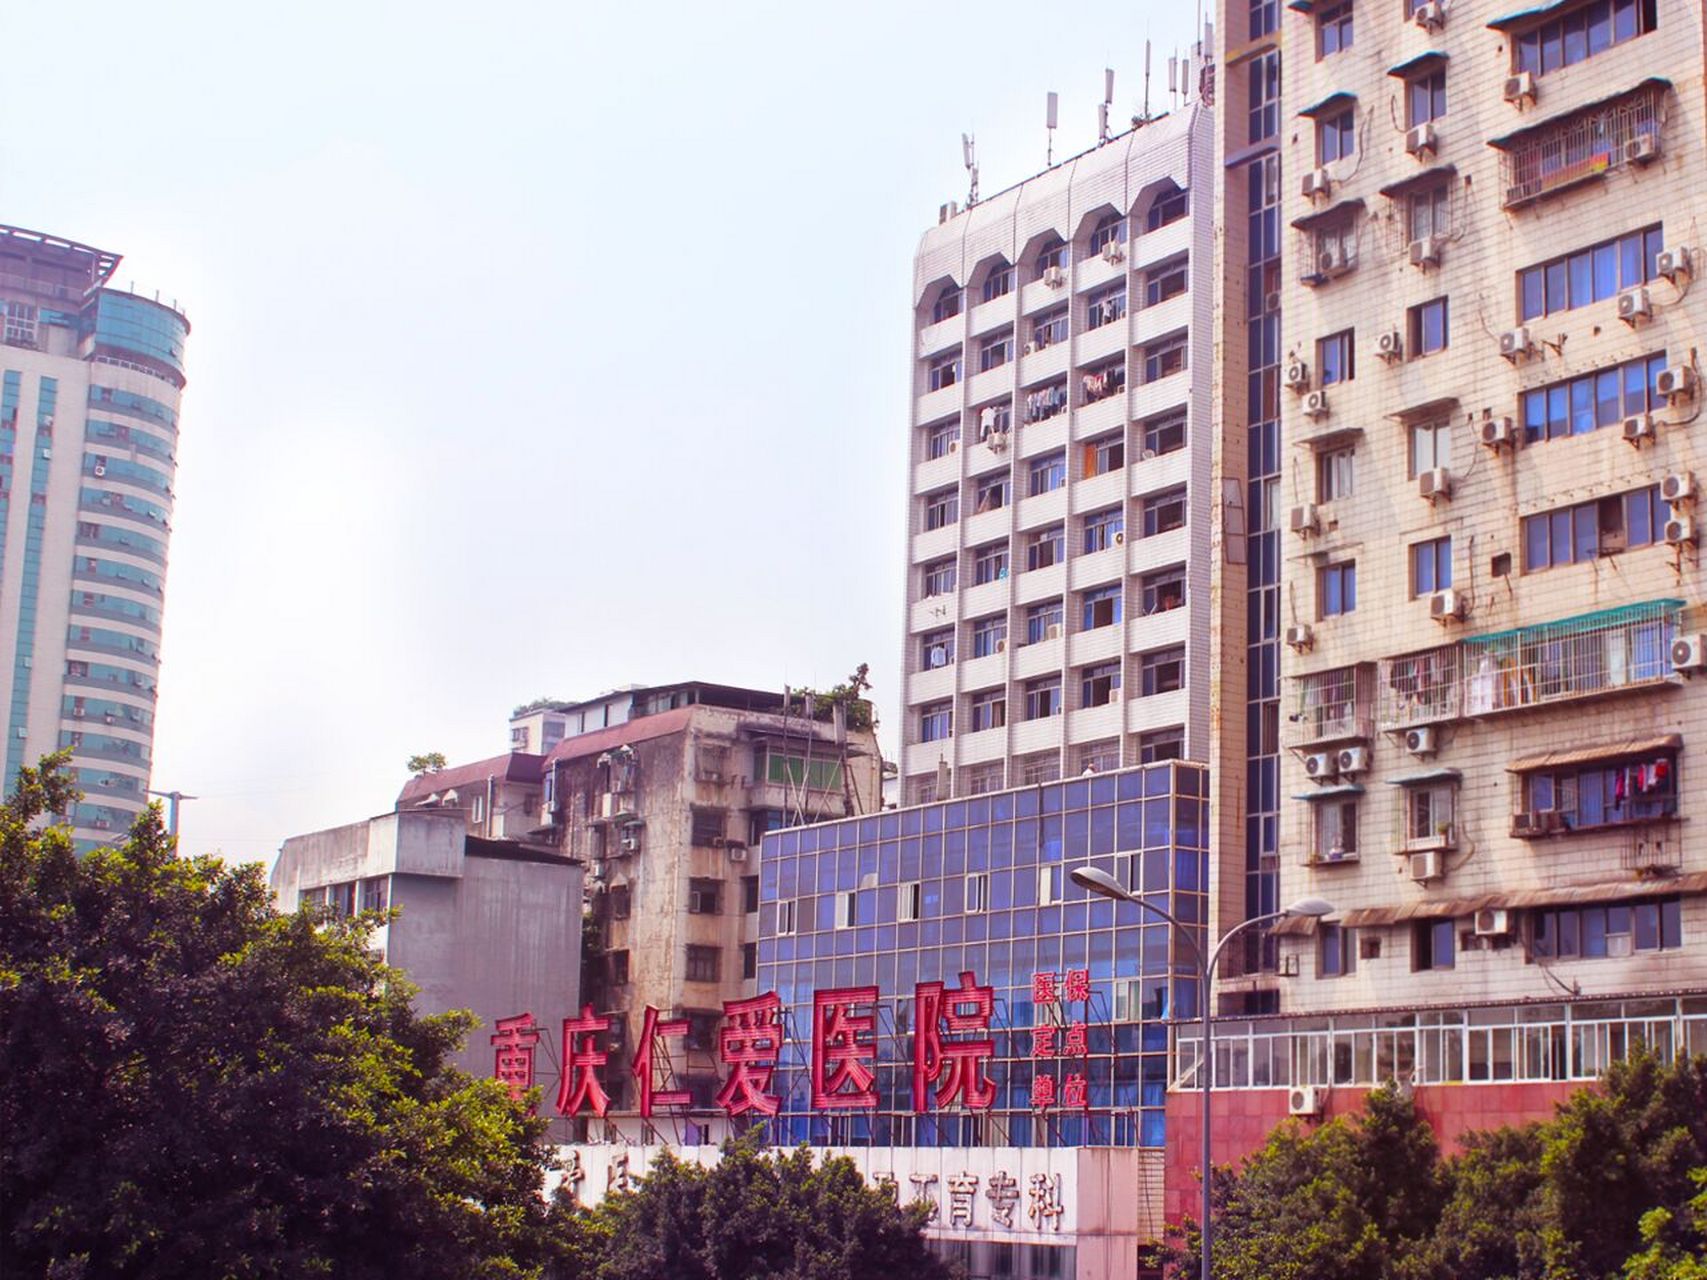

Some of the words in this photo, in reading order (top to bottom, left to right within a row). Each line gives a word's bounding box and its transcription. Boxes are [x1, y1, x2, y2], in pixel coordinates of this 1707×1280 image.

[1031, 968, 1089, 1004] 医保
[491, 970, 996, 1118] 重庆仁爱医院
[1030, 1020, 1088, 1057] 定点
[1030, 1073, 1088, 1112] 单位
